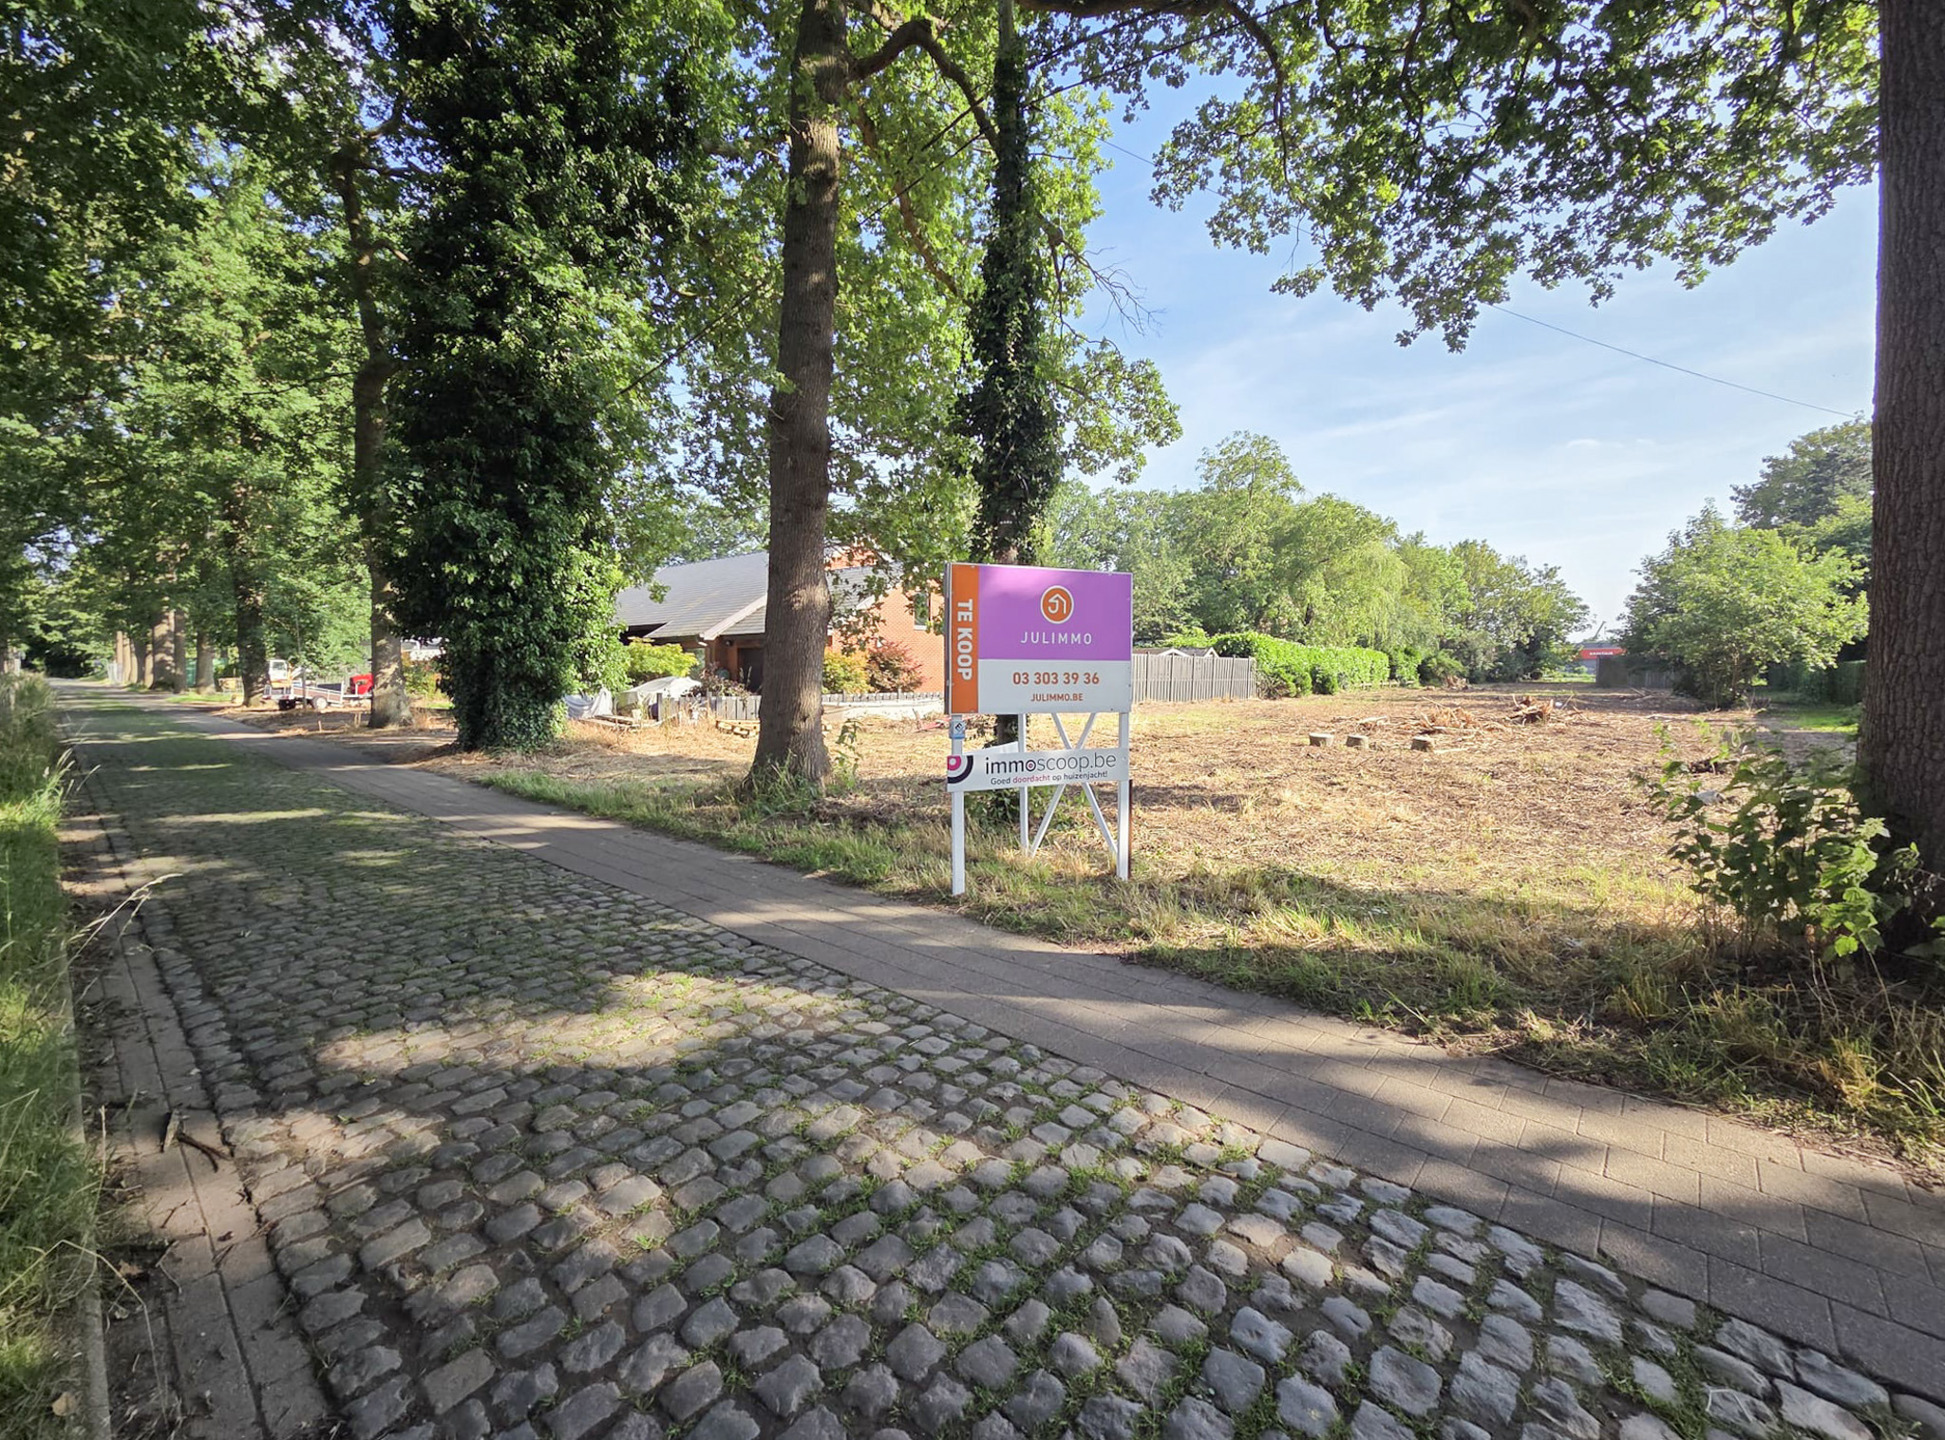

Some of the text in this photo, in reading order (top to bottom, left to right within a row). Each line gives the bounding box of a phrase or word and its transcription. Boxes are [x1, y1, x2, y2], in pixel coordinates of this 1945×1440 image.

[957, 599, 973, 681] TE KOOP
[1020, 631, 1093, 645] JULIMMO
[1012, 671, 1100, 685] 03 303 39 36
[1030, 693, 1084, 702] JULIMMO.BE
[985, 752, 1117, 775] immoscoop.be
[990, 776, 1011, 785] Goed
[1012, 774, 1051, 784] doordacht
